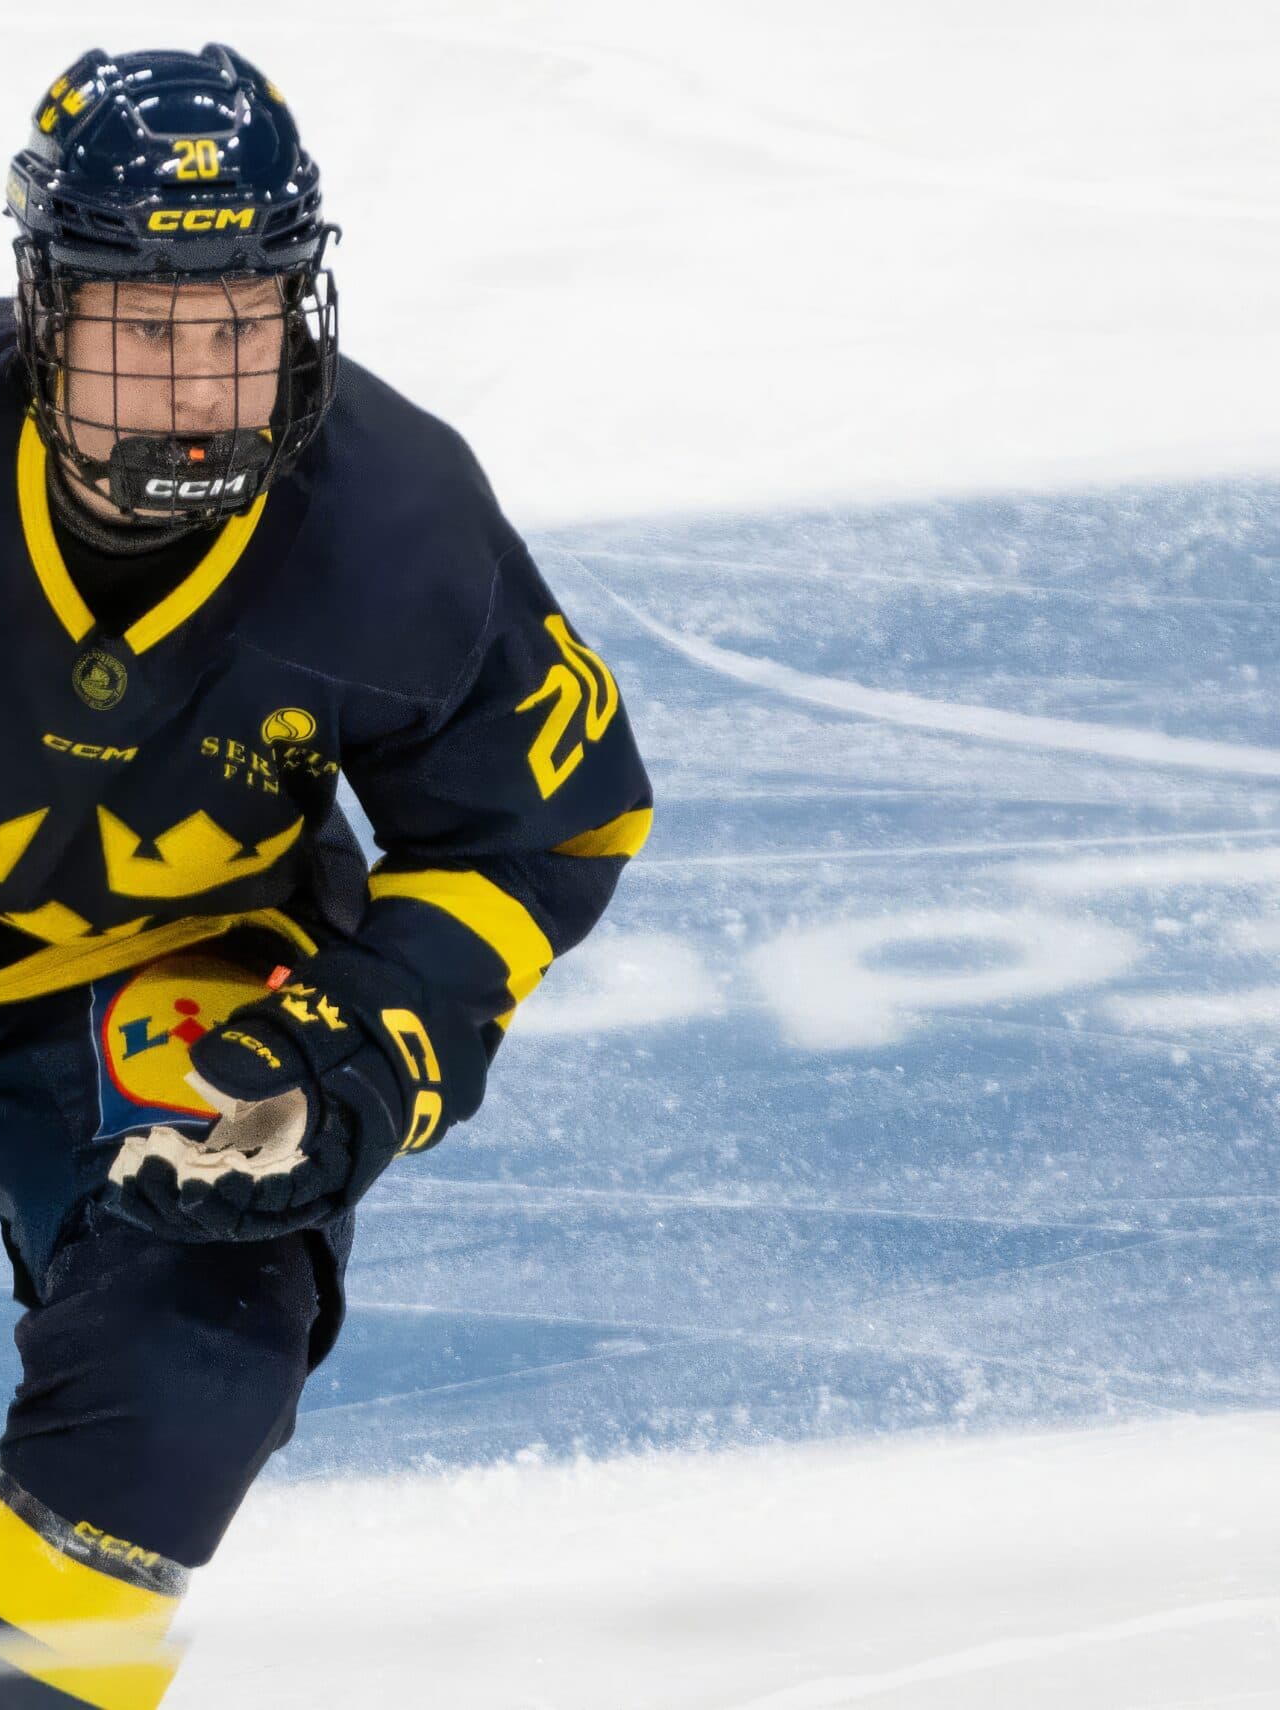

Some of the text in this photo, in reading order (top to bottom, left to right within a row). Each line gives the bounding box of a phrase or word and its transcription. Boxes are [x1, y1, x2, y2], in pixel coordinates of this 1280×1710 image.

[172, 140, 220, 179] 20
[147, 208, 255, 231] CCM
[145, 472, 247, 499] CCM
[515, 614, 619, 800] 20
[41, 733, 139, 761] CCM
[221, 1031, 281, 1069] CCM
[74, 1520, 161, 1567] CCM
